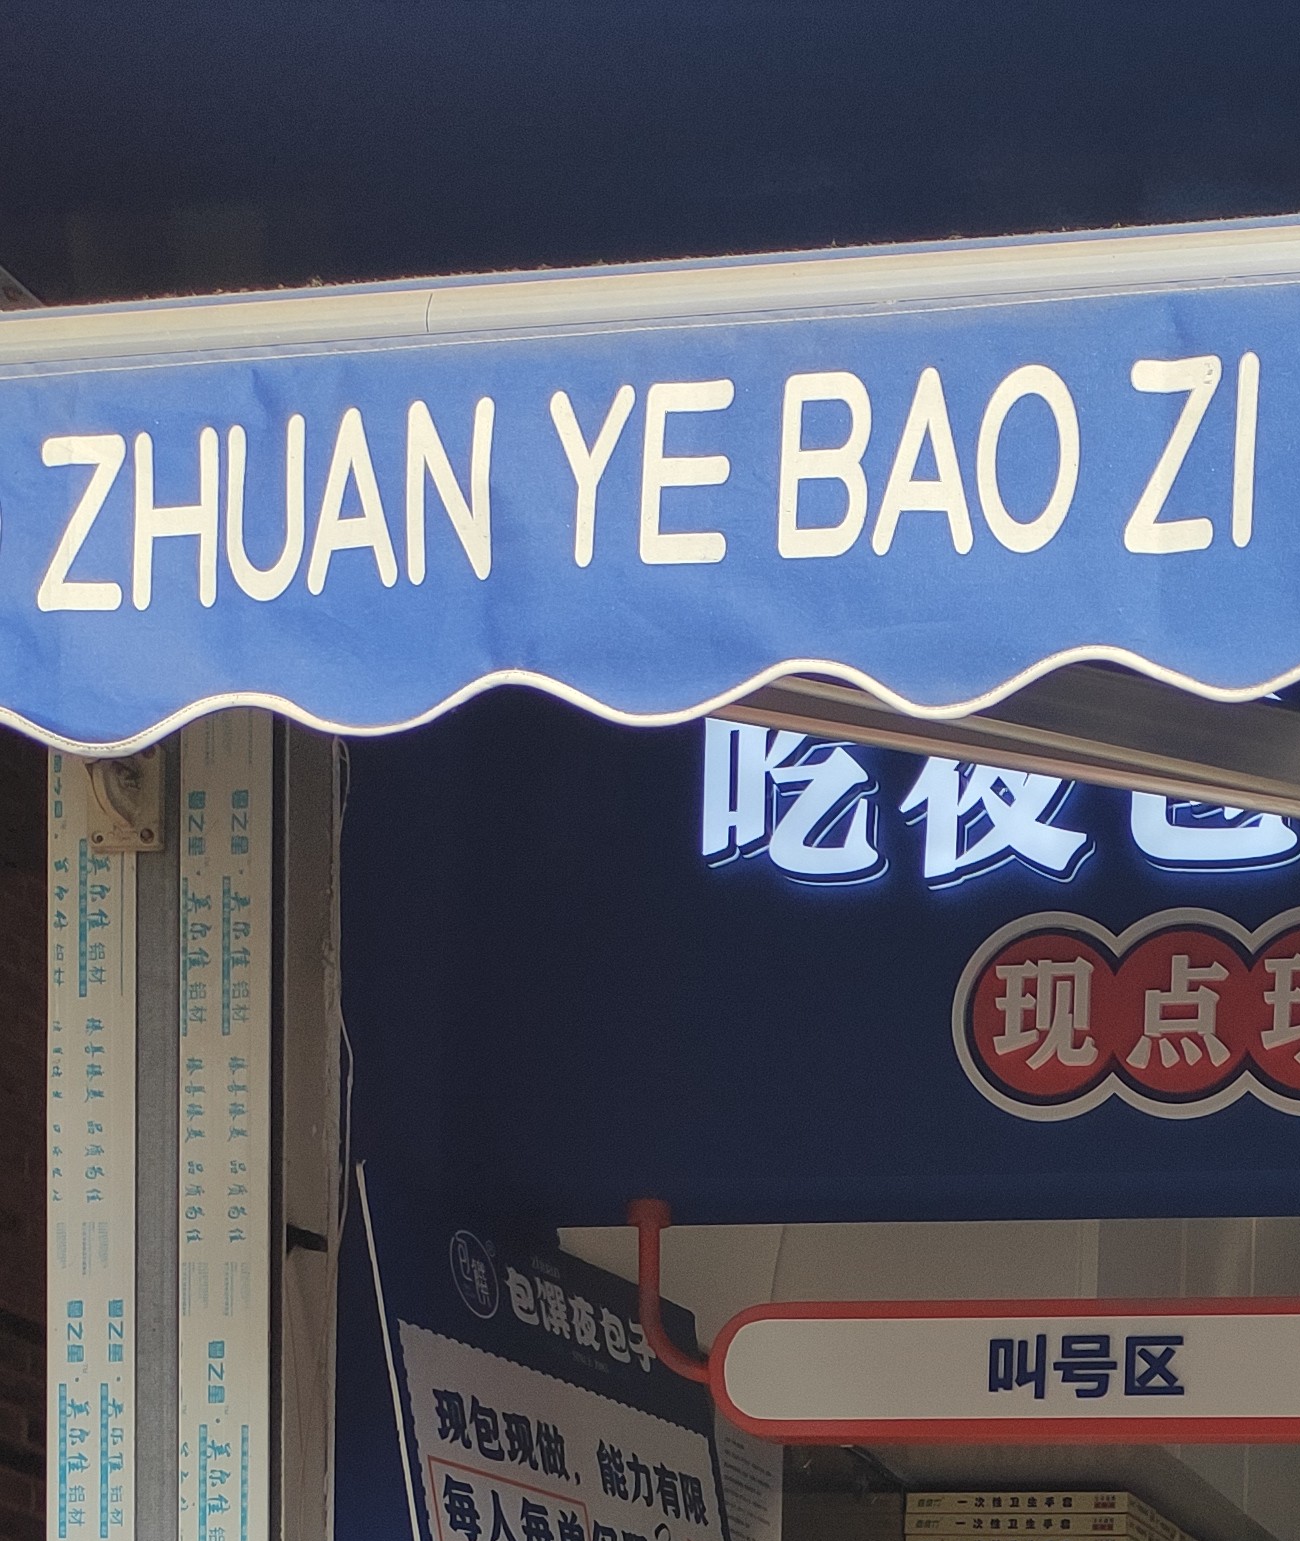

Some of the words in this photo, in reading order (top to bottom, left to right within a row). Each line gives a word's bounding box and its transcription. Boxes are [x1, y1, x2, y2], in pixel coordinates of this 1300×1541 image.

[37, 396, 497, 613] ZHUAN
[549, 378, 736, 569] YE
[777, 362, 1082, 562] BAO
[1122, 351, 1261, 556] ZI
[504, 1266, 656, 1372] 包馔夜包子
[986, 1335, 1187, 1400] 叫号区
